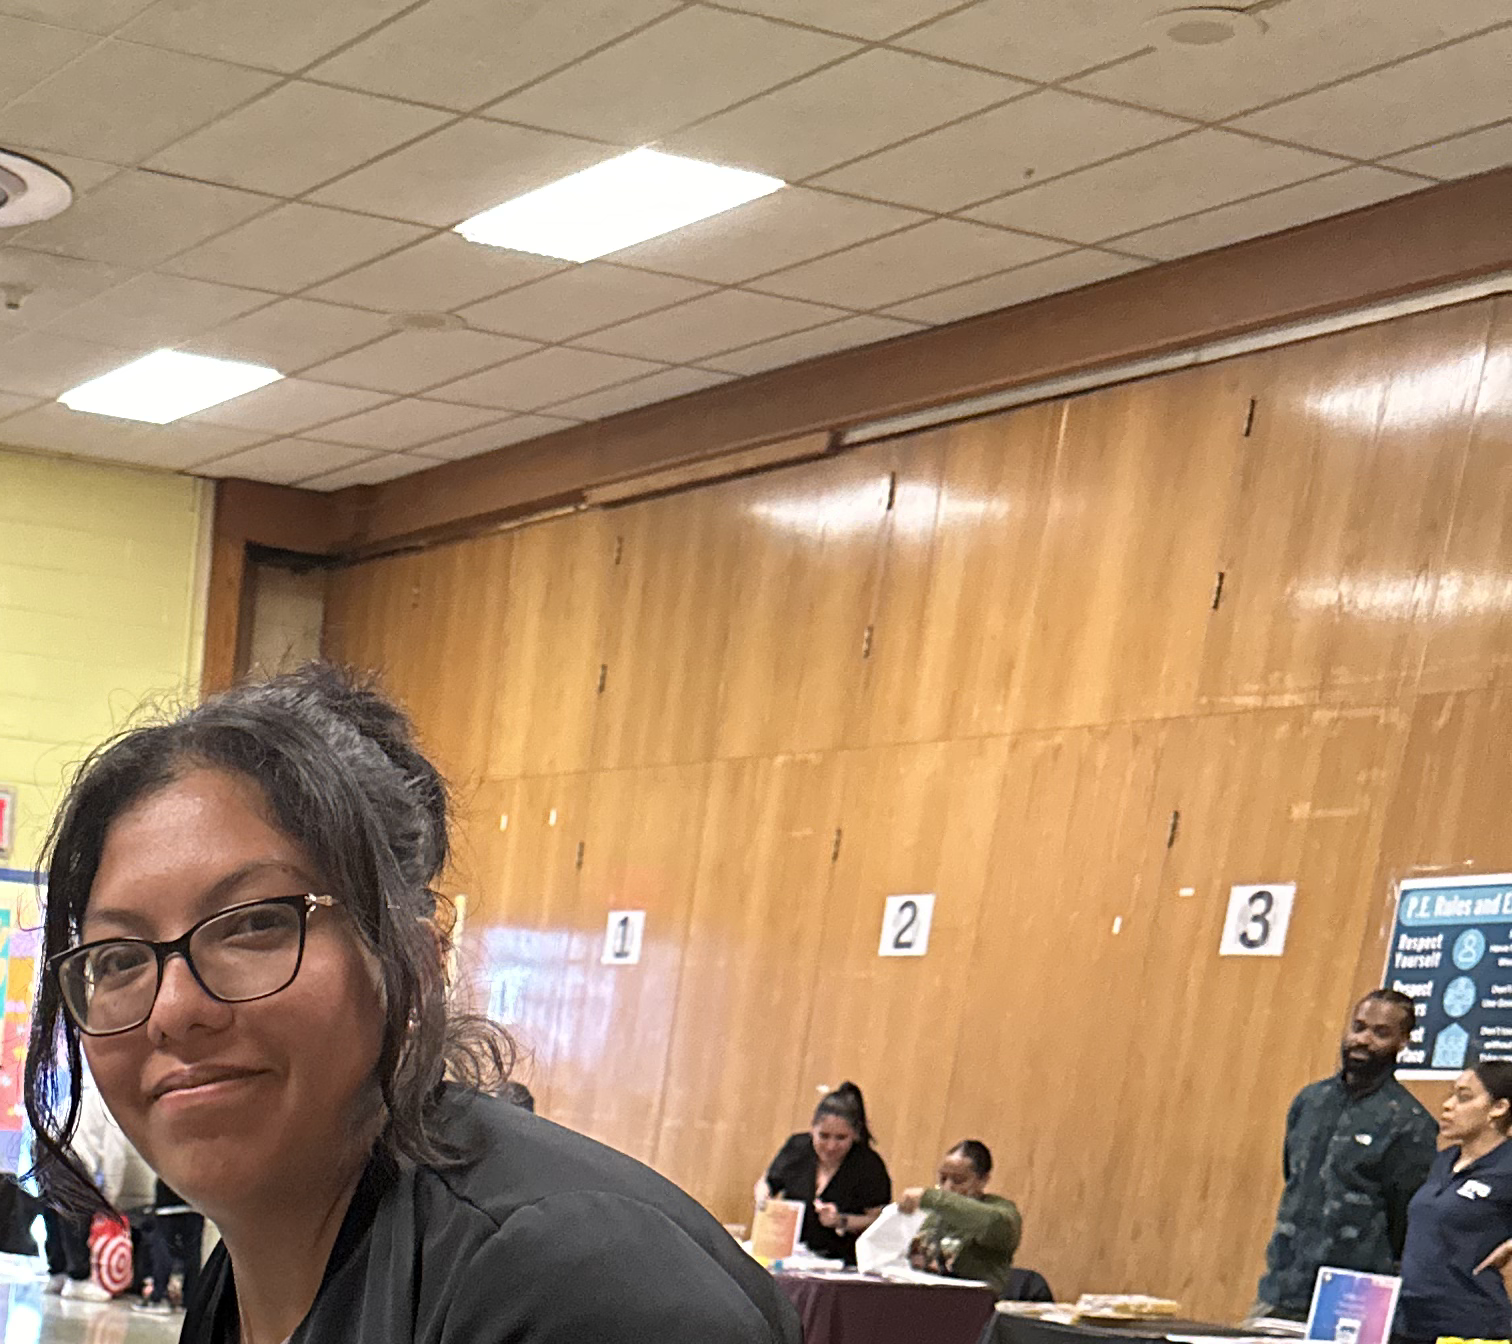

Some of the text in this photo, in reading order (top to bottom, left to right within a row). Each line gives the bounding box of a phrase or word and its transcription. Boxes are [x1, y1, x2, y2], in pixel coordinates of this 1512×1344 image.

[613, 916, 629, 958] 1
[893, 900, 917, 949] 2
[1239, 890, 1273, 949] 3
